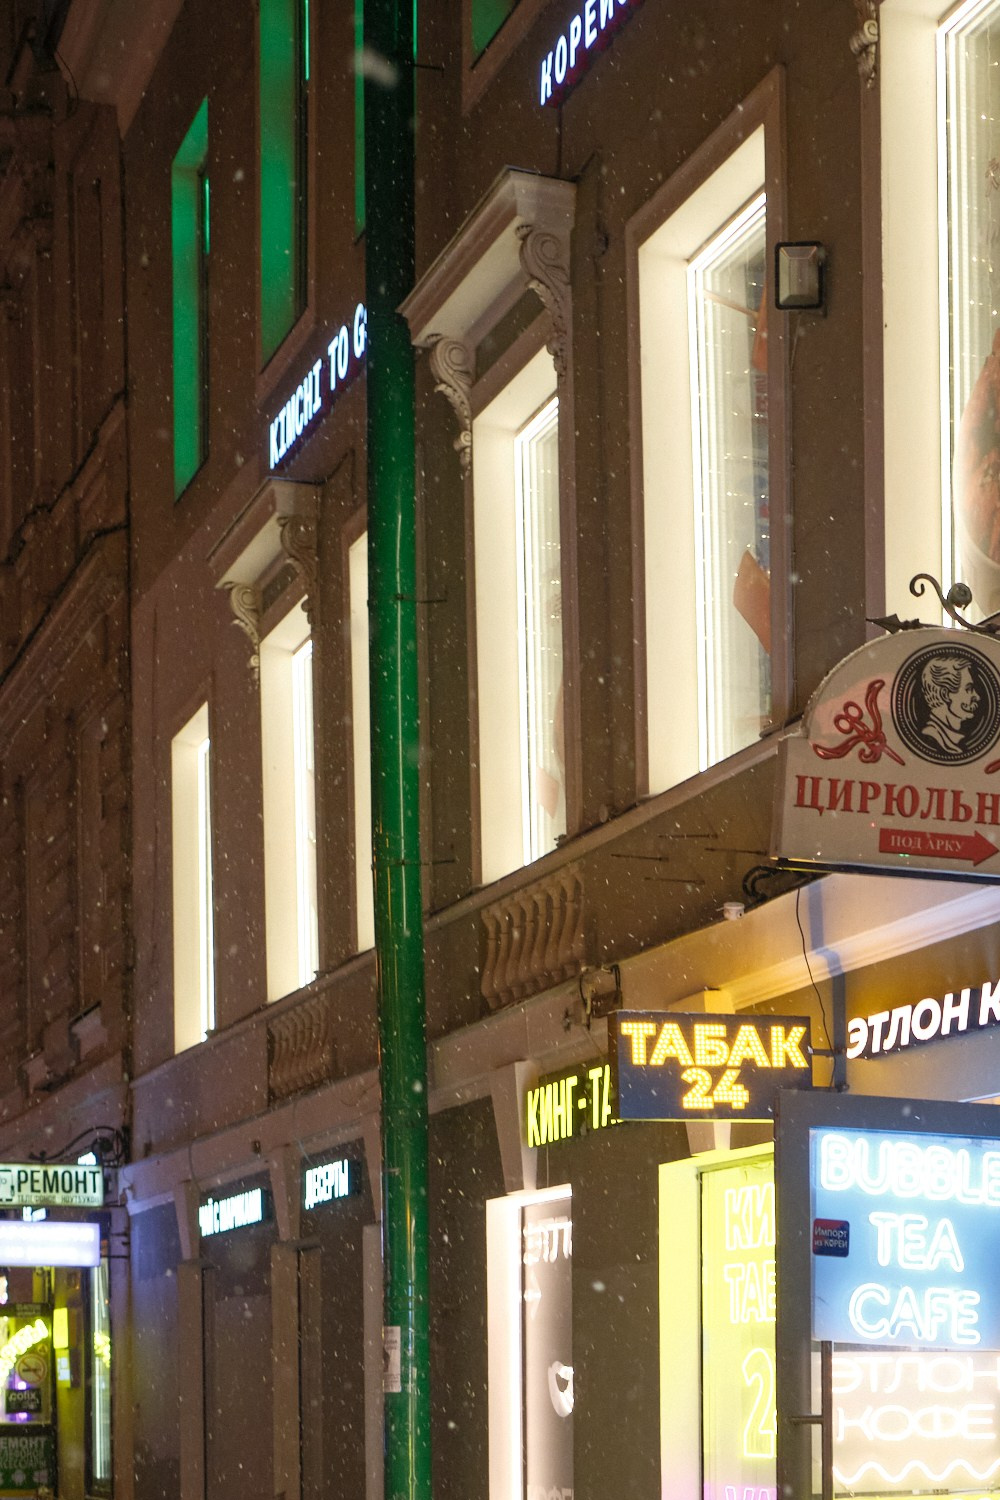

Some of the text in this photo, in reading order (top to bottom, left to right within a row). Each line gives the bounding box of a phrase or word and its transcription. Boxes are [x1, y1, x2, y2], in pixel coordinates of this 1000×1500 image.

[270, 302, 368, 470] KIMCHI TO G
[891, 834, 965, 852] ПОД АРКУ
[621, 1021, 810, 1068] ТАБАК
[846, 988, 971, 1060] ЭТЛОН
[681, 1066, 750, 1110] 24
[17, 1169, 101, 1194] РЕМОНТ
[815, 1226, 848, 1239] Импорт
[869, 1211, 965, 1272] TEA
[849, 1282, 981, 1345] CAFE
[836, 1402, 996, 1443] КОФЕ
